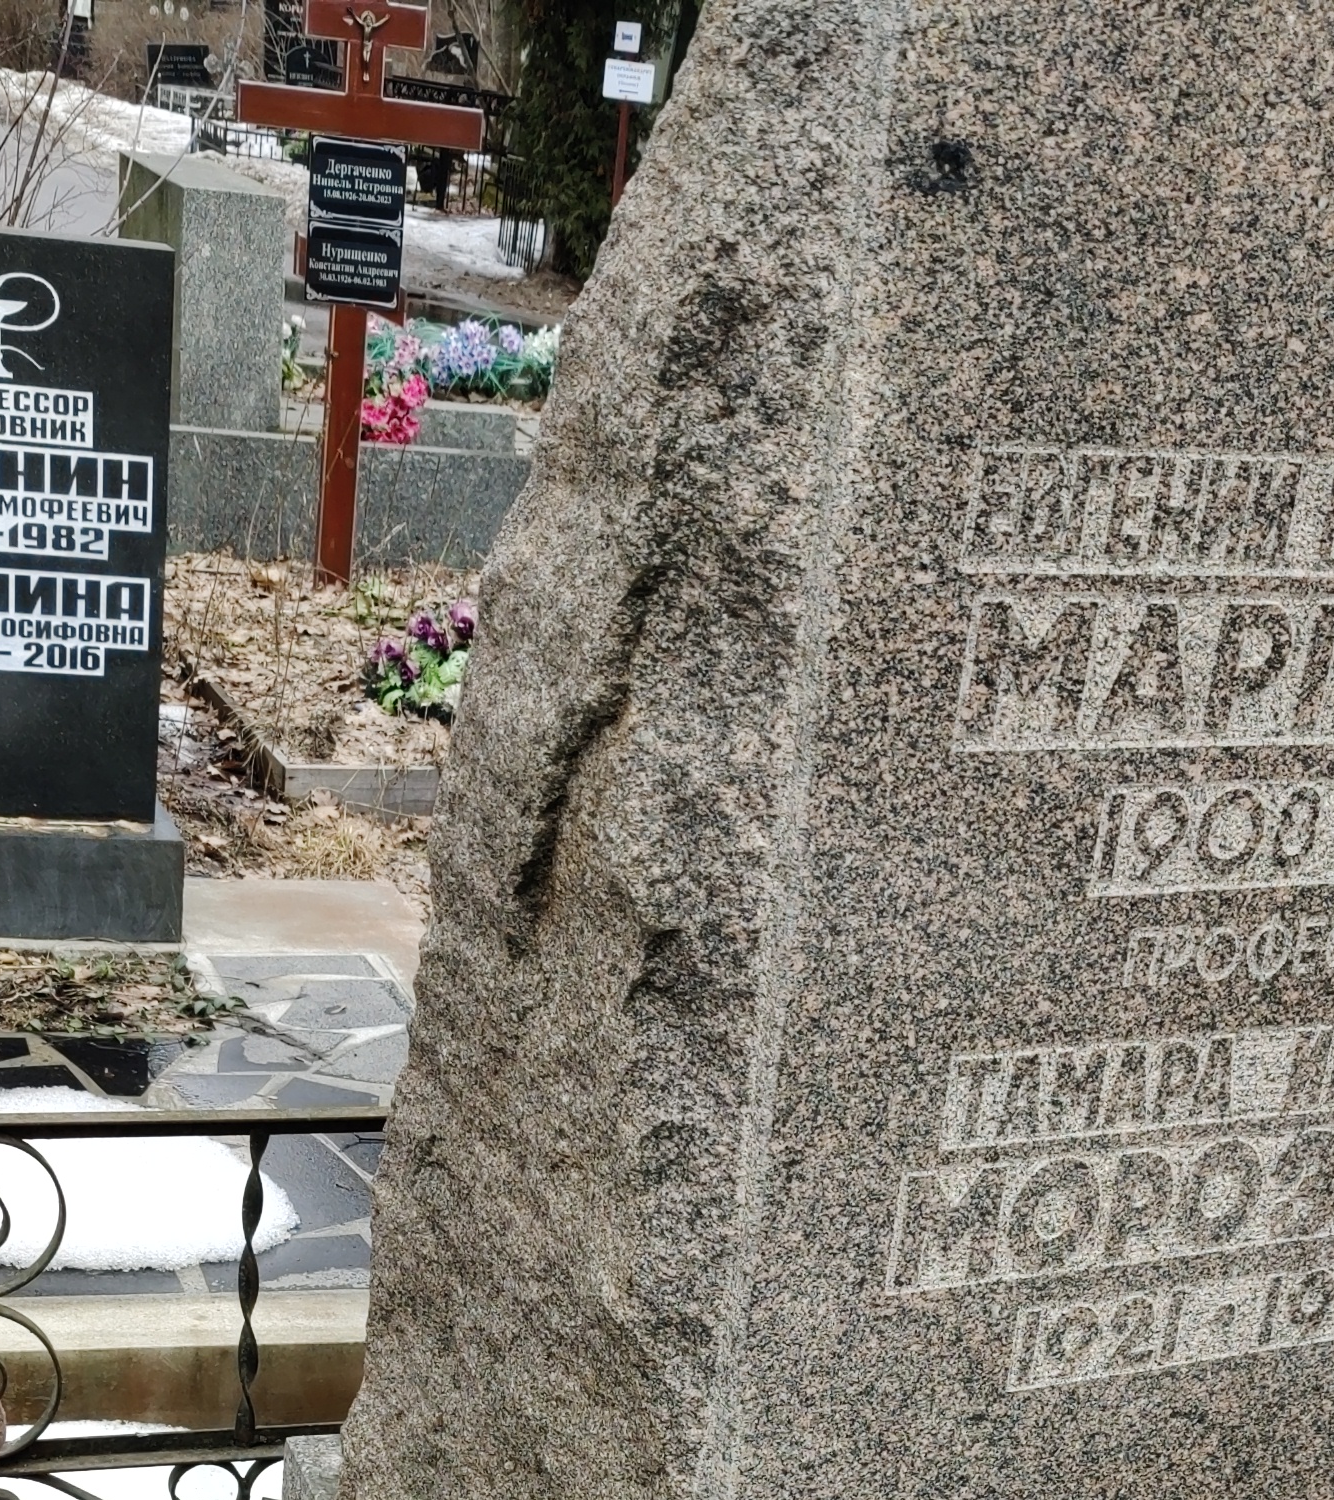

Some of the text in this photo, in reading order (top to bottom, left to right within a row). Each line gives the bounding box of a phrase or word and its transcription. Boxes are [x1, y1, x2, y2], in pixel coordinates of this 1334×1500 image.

[325, 158, 392, 181] Дергаченко
[312, 173, 403, 195] Нинель Петровна
[321, 242, 387, 264] Нурищенко
[309, 257, 399, 279] Константин Андреевич
[970, 450, 1301, 564] ЕВГЕНИЙ
[953, 1038, 1234, 1143] ТАМАРА
